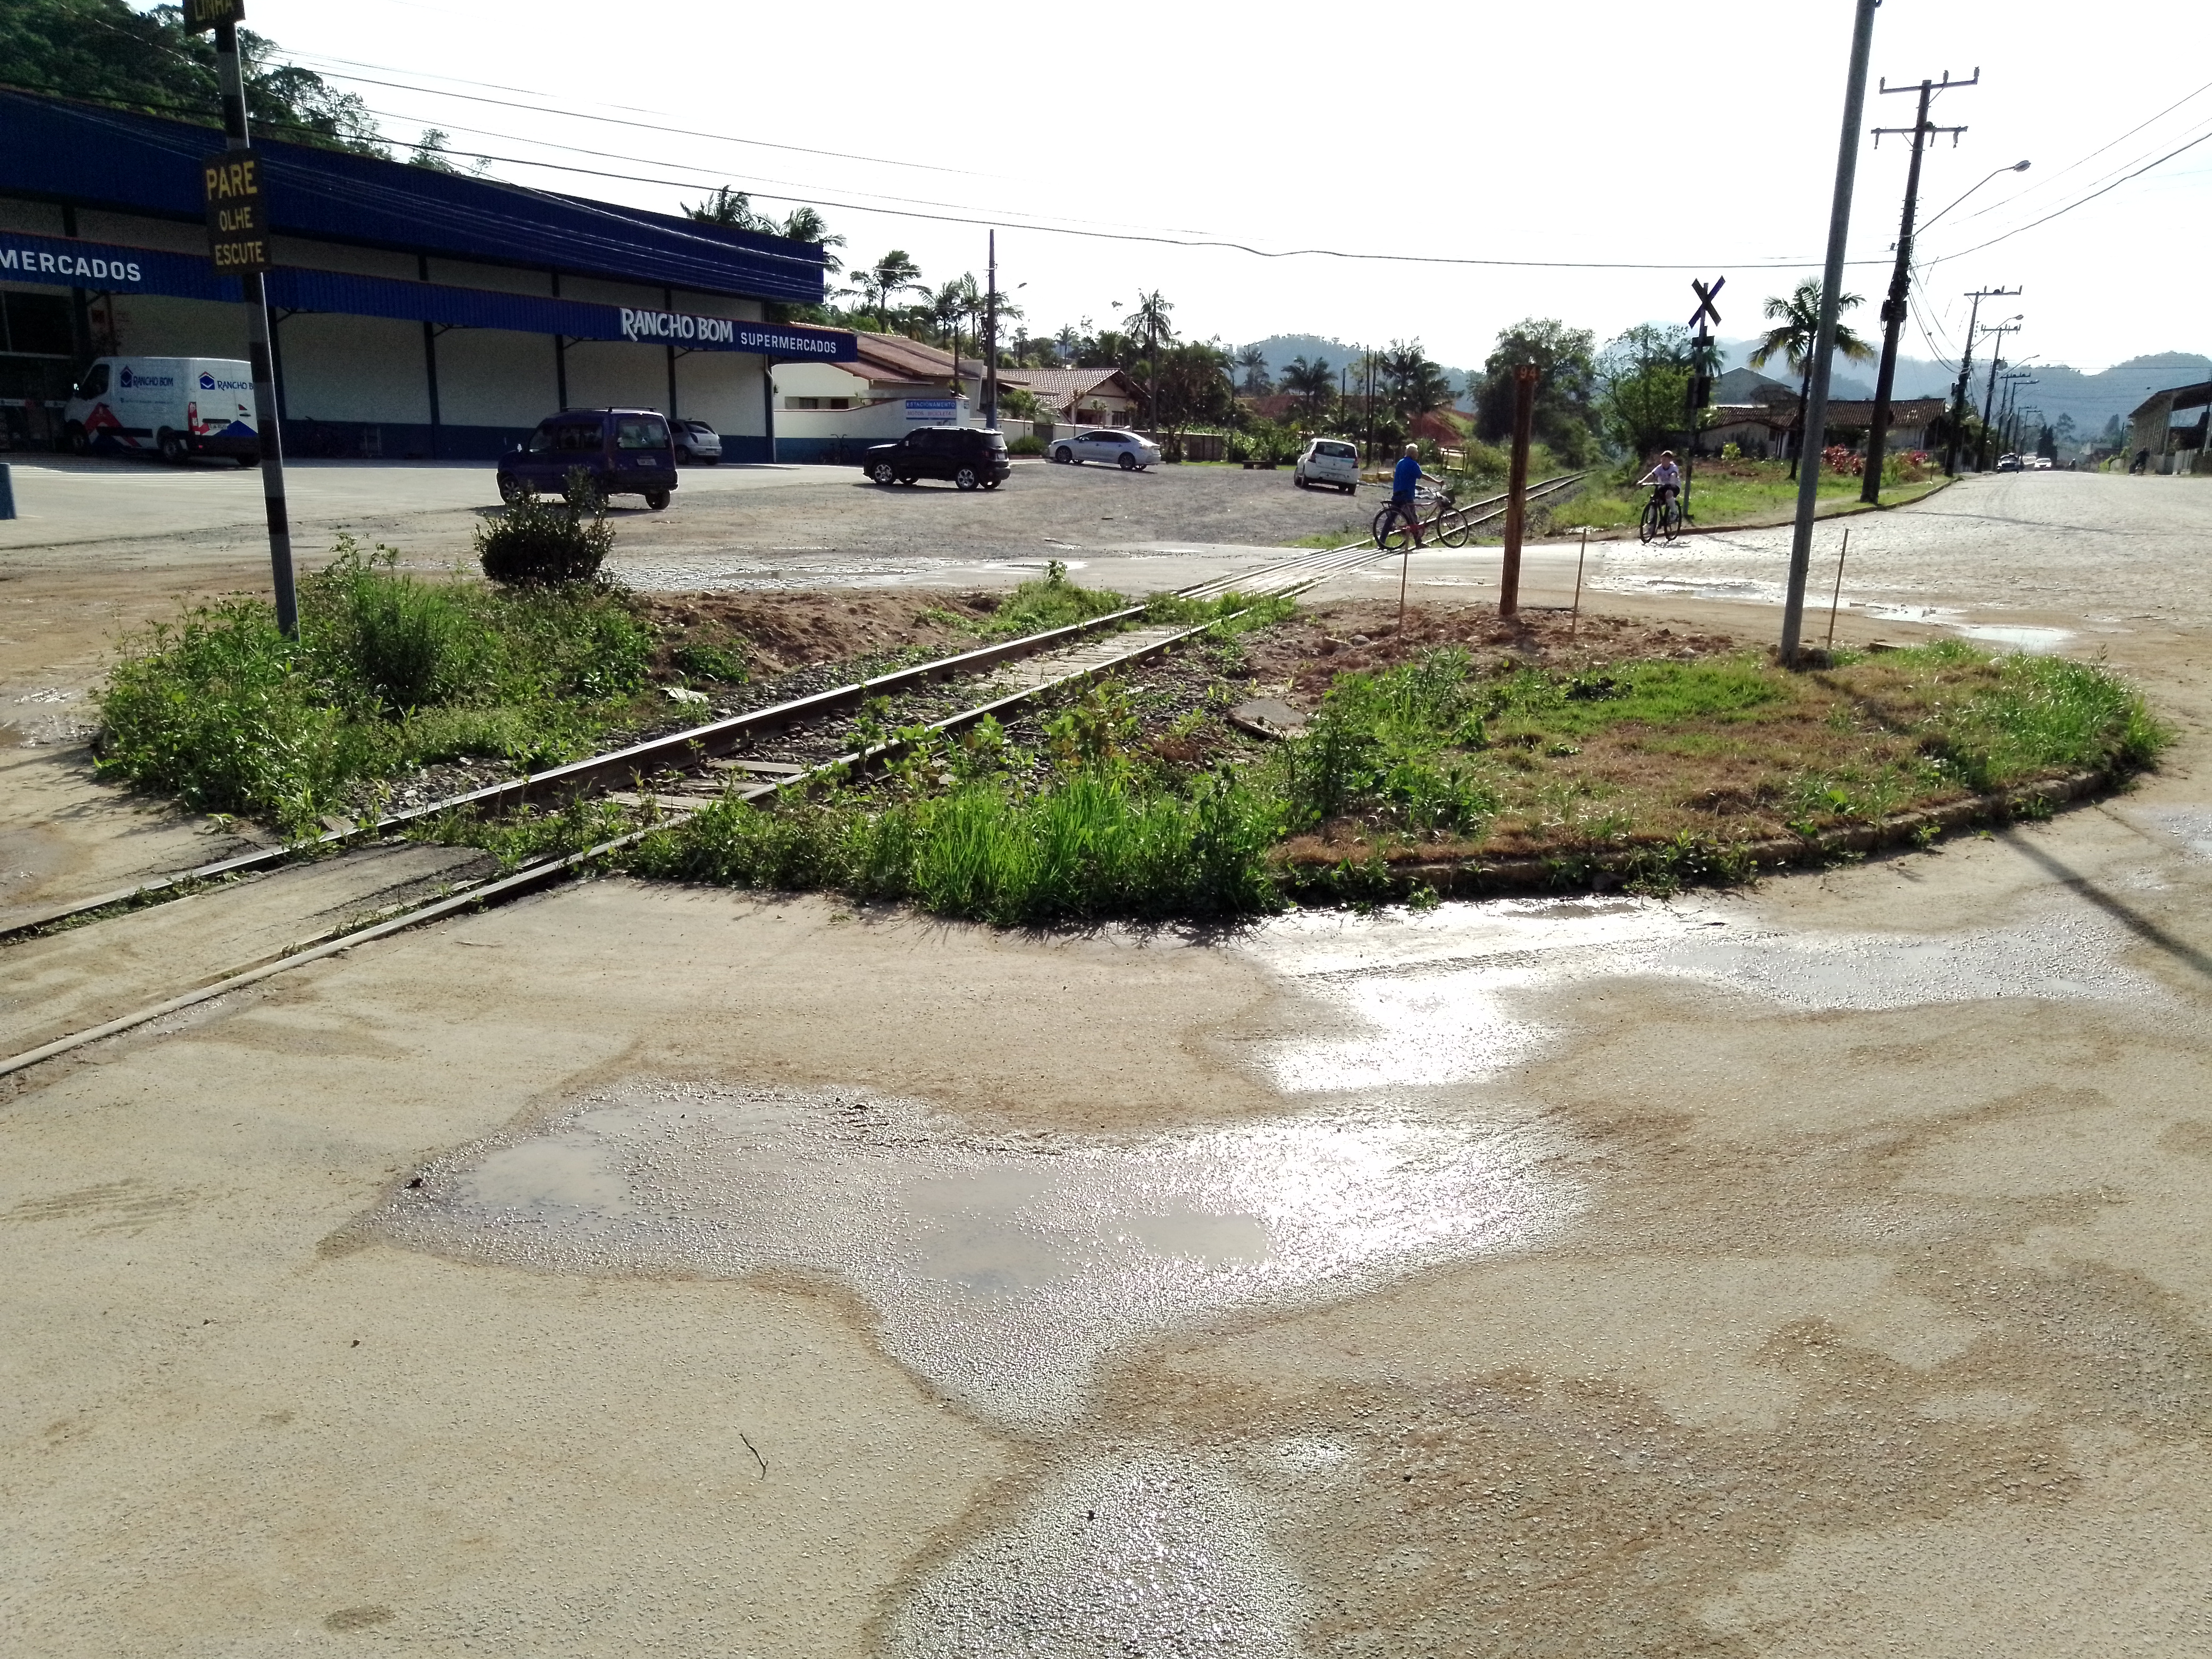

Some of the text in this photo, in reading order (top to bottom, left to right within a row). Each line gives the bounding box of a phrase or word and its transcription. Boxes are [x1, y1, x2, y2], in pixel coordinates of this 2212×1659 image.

[206, 161, 257, 200] PARE
[219, 206, 254, 232] OLHE
[0, 249, 141, 282] MERCADOS
[214, 241, 265, 266] ESCUTE
[619, 307, 734, 343] RANCHO BOM
[741, 332, 836, 354] SUPERMERCADOS
[133, 375, 173, 387] RANCHO BOM
[217, 380, 248, 391] RANCHO
